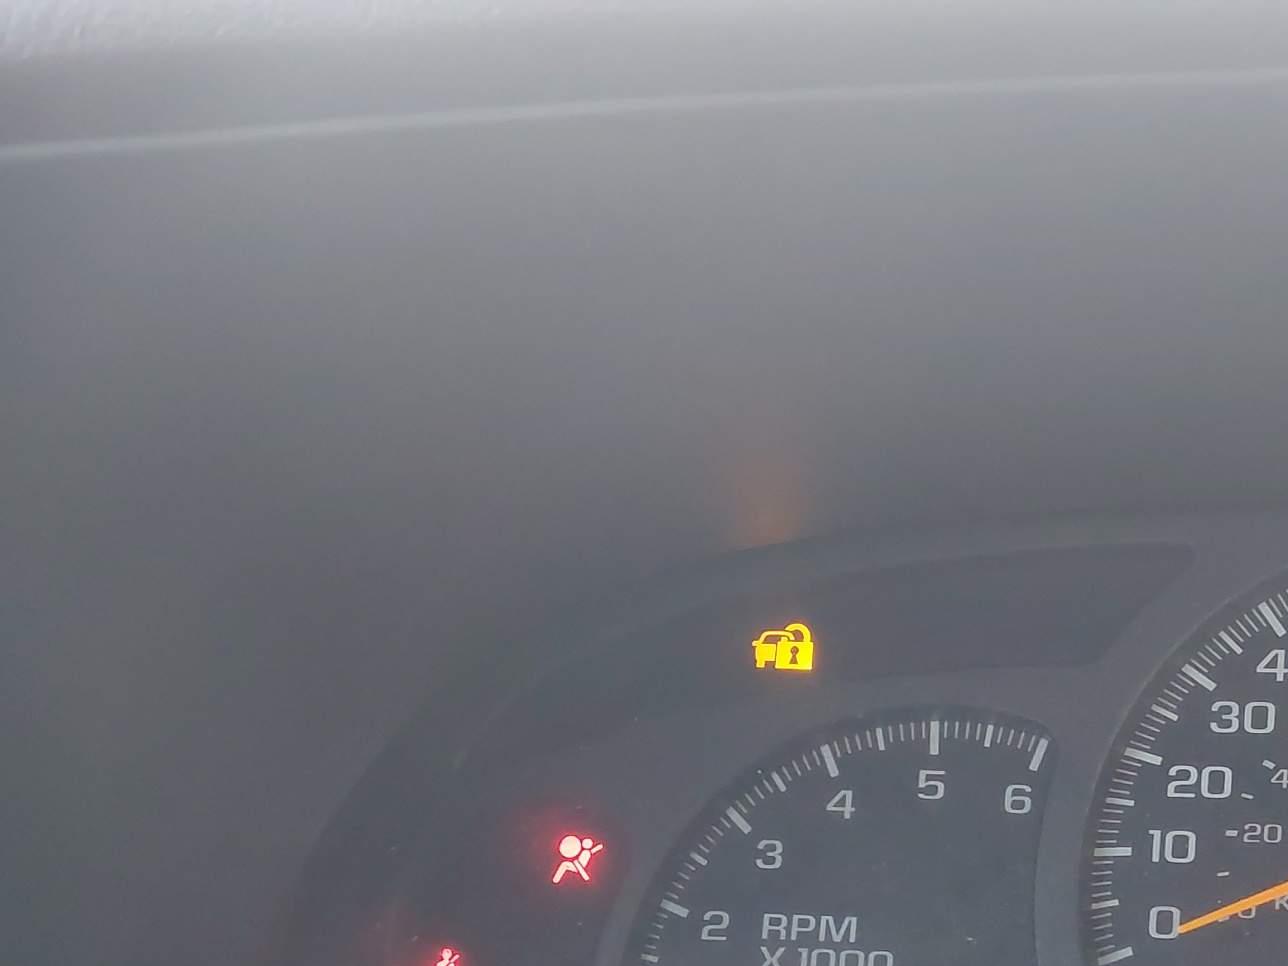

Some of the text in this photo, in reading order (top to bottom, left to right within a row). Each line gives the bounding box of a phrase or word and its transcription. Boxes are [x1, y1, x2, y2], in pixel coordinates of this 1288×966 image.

[1210, 701, 1276, 735] 30
[917, 769, 946, 801] 5
[1167, 765, 1232, 799] 20
[825, 789, 856, 820] 4
[1004, 785, 1032, 815] 6
[1147, 830, 1197, 863] 10
[1243, 823, 1283, 844] 20
[755, 840, 784, 870] 3
[701, 911, 730, 941] 2
[761, 914, 858, 942] RPM
[1147, 906, 1181, 939] 0
